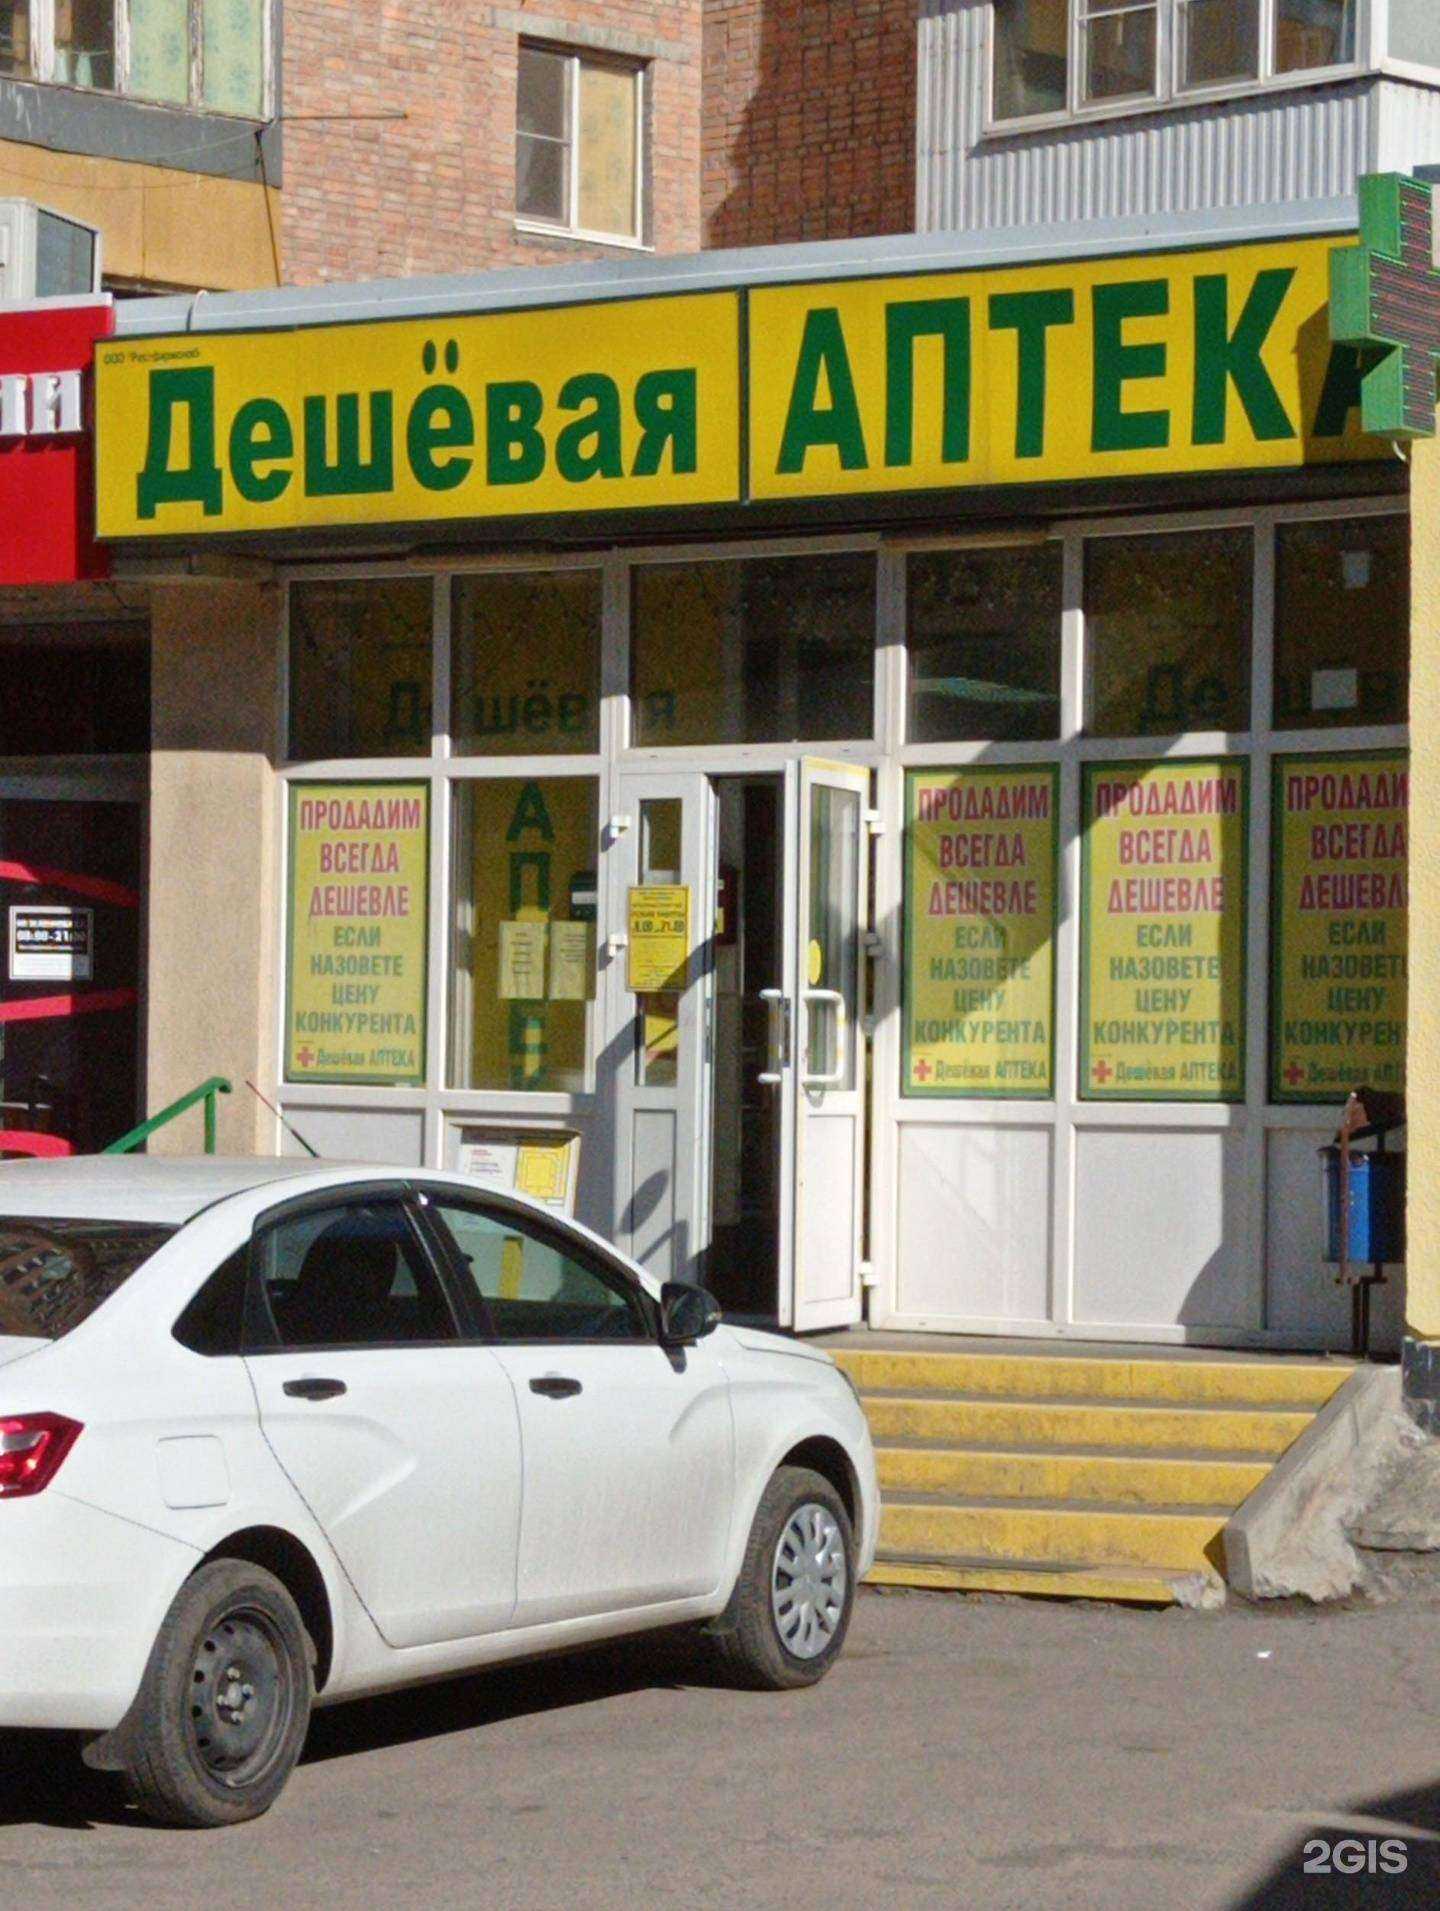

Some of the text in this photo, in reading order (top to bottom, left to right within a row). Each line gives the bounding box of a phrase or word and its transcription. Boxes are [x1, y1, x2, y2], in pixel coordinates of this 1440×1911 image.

[136, 339, 697, 520] Дешёвая
[918, 784, 1048, 821] ПРОДАДИМ
[1095, 778, 1237, 817] ПРОДАДИМ
[1287, 772, 1409, 811] ПРОДАДИ
[300, 799, 421, 831] ПРОДАДИМ
[939, 833, 1026, 868] ВСЕГДА
[1119, 828, 1212, 865] ВСЕГДА
[1311, 821, 1407, 860] ВСЕГДА
[320, 842, 399, 873] ВСЕГДА
[309, 886, 409, 916] ДЕШЕВЛЕ
[928, 880, 1037, 916] ДЕШЕВЛЕ
[1108, 877, 1225, 914] ДЕШЕВЛЕ
[1300, 873, 1405, 910] ДЕШЕВЛ
[333, 926, 381, 947] ЕСЛИ
[954, 925, 1006, 949] ЕСЛИ
[1137, 923, 1192, 947] ЕСЛИ
[1329, 920, 1386, 946] ЕСЛИ
[310, 955, 403, 977] НАЗОВЕТЕ
[930, 957, 1031, 981] НАЗОВЕТЕ
[1109, 956, 1219, 980] НАЗОВЕТЕ
[1302, 955, 1408, 979] НАЗОВЕТ
[332, 985, 380, 1006] ЦЕНУ
[954, 988, 1005, 1012] ЦЕНУ
[1135, 988, 1192, 1013] ЦЕНУ
[1328, 986, 1386, 1012] ЦЕНУ
[296, 1012, 416, 1034] КОНКУРЕНТА
[915, 1020, 1046, 1044] КОНКУРЕНТА
[1094, 1020, 1235, 1045] КОНКУРЕНТА
[1284, 1020, 1400, 1046] КОНКУРЕН
